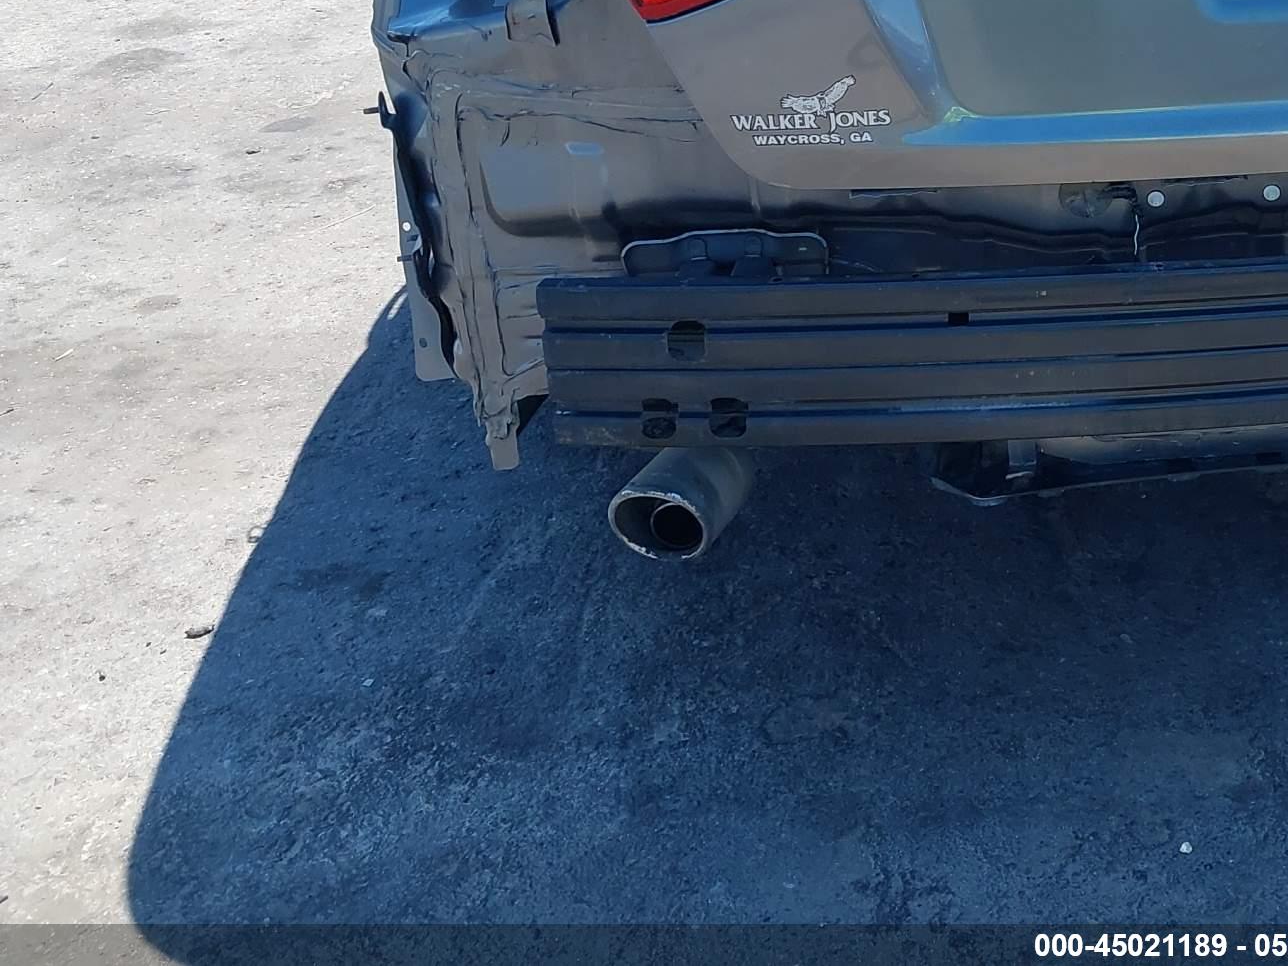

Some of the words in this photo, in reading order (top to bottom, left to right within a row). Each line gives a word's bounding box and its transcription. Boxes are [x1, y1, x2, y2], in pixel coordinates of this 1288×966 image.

[731, 114, 819, 131] WALKER
[829, 109, 891, 132] JONES
[753, 134, 845, 146] WAYCROSS,
[850, 132, 873, 143] GA
